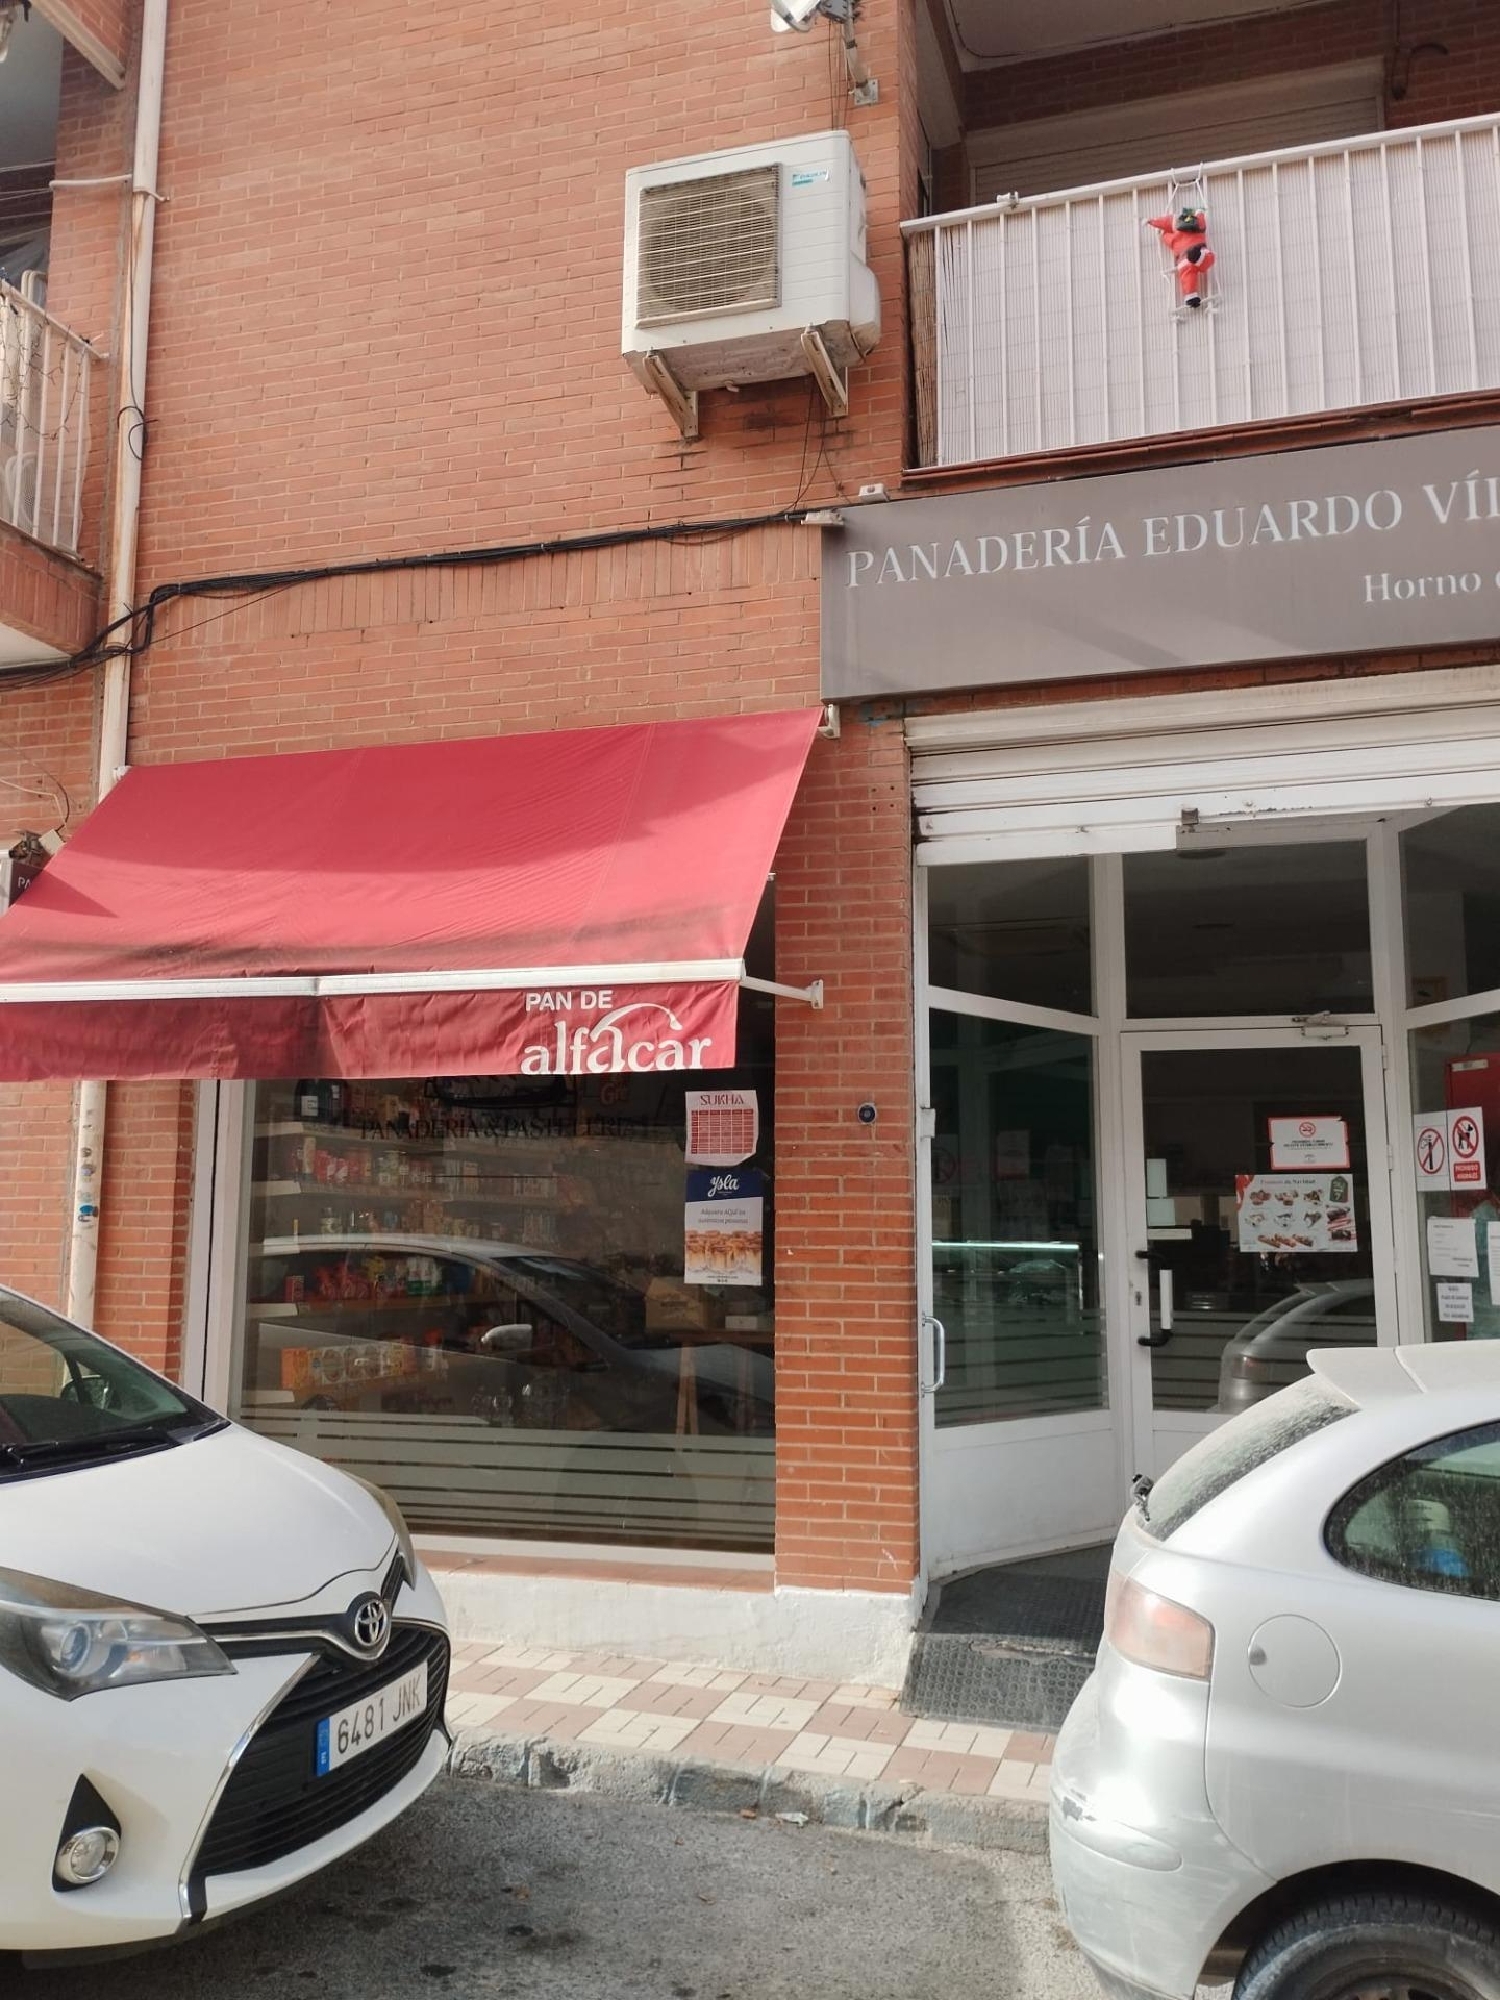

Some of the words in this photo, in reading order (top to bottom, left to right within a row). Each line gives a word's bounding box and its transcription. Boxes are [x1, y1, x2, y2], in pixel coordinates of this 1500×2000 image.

[846, 516, 1126, 588] PANADERÍA
[1142, 489, 1404, 557] EDUARDO
[1364, 572, 1482, 603] Horno
[525, 991, 572, 1012] PAN
[580, 990, 614, 1010] DE
[337, 1697, 385, 1755] 6481
[392, 1674, 422, 1722] JNK
